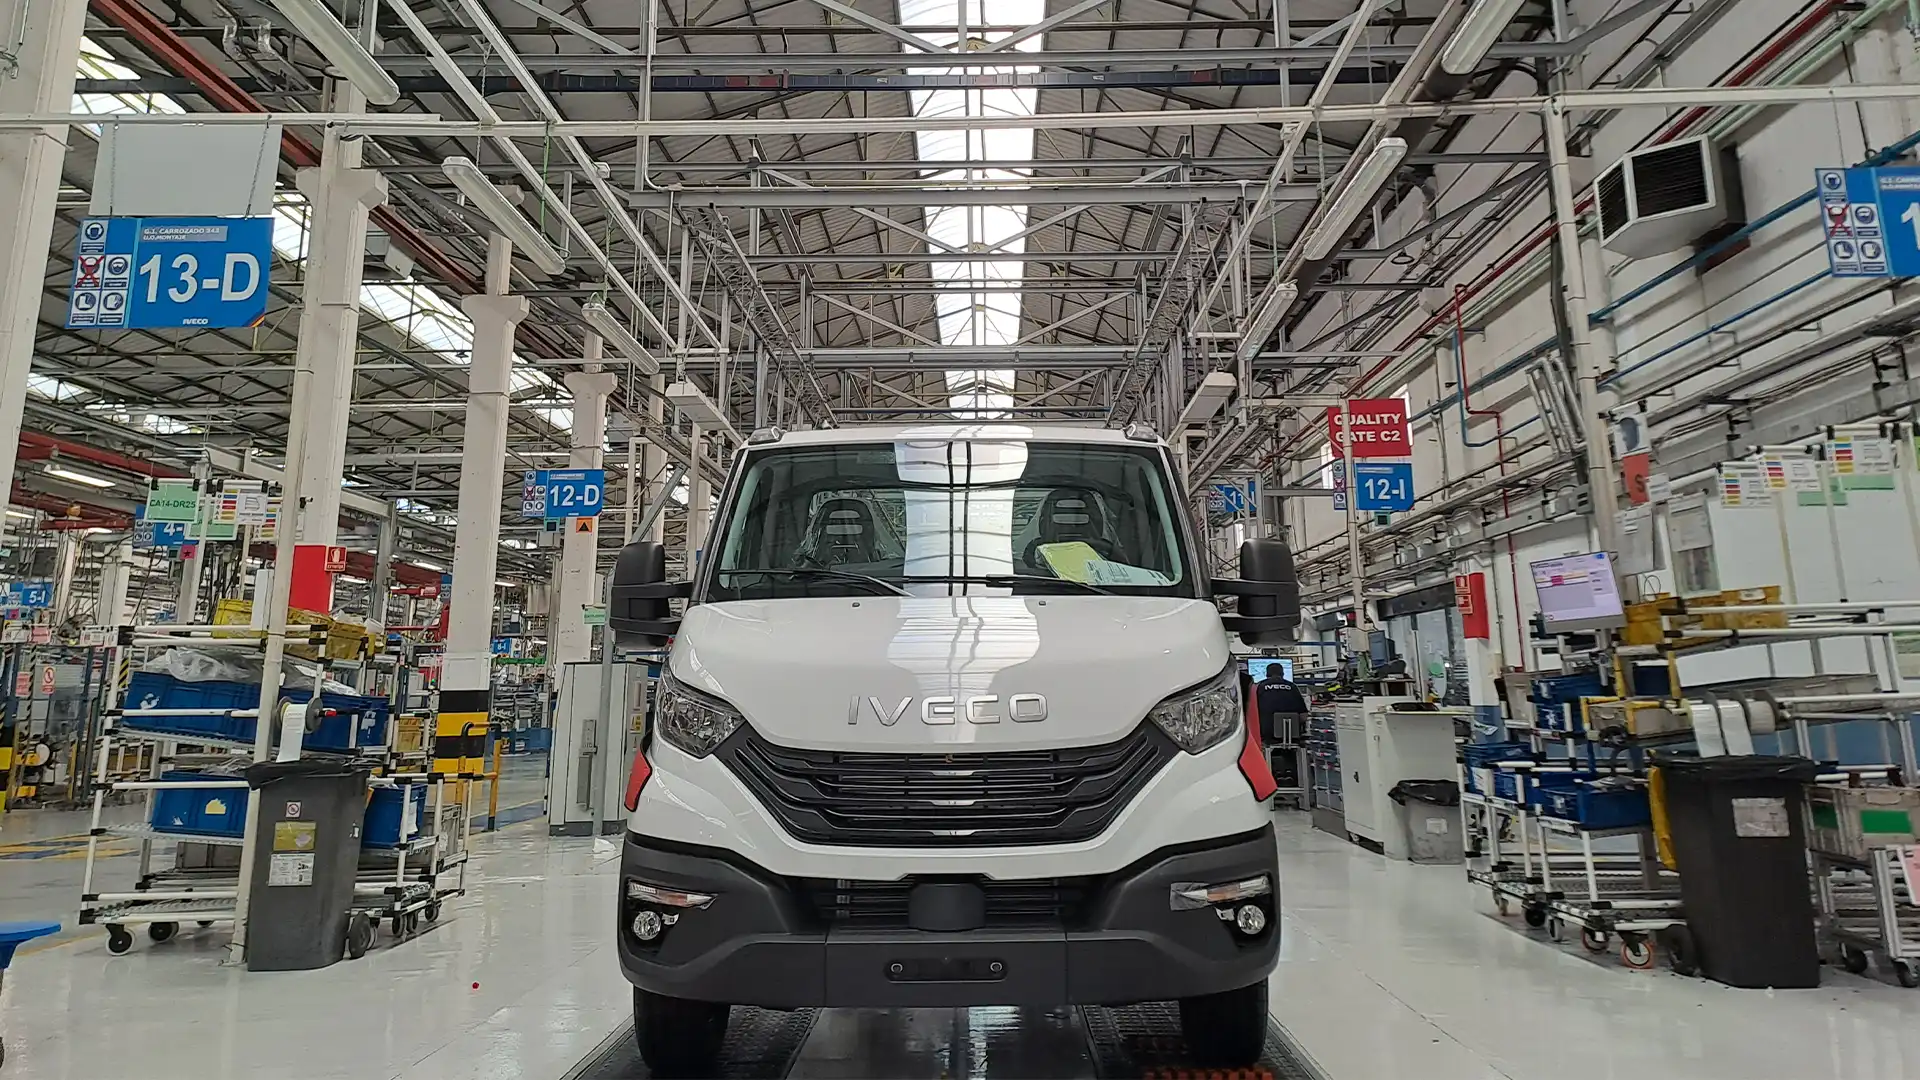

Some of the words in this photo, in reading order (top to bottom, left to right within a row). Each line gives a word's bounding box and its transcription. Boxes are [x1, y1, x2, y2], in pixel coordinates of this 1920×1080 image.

[139, 253, 260, 303] 13-D
[1380, 430, 1401, 442] C2
[549, 484, 600, 507] 12-D
[847, 693, 1048, 727] IVECO
